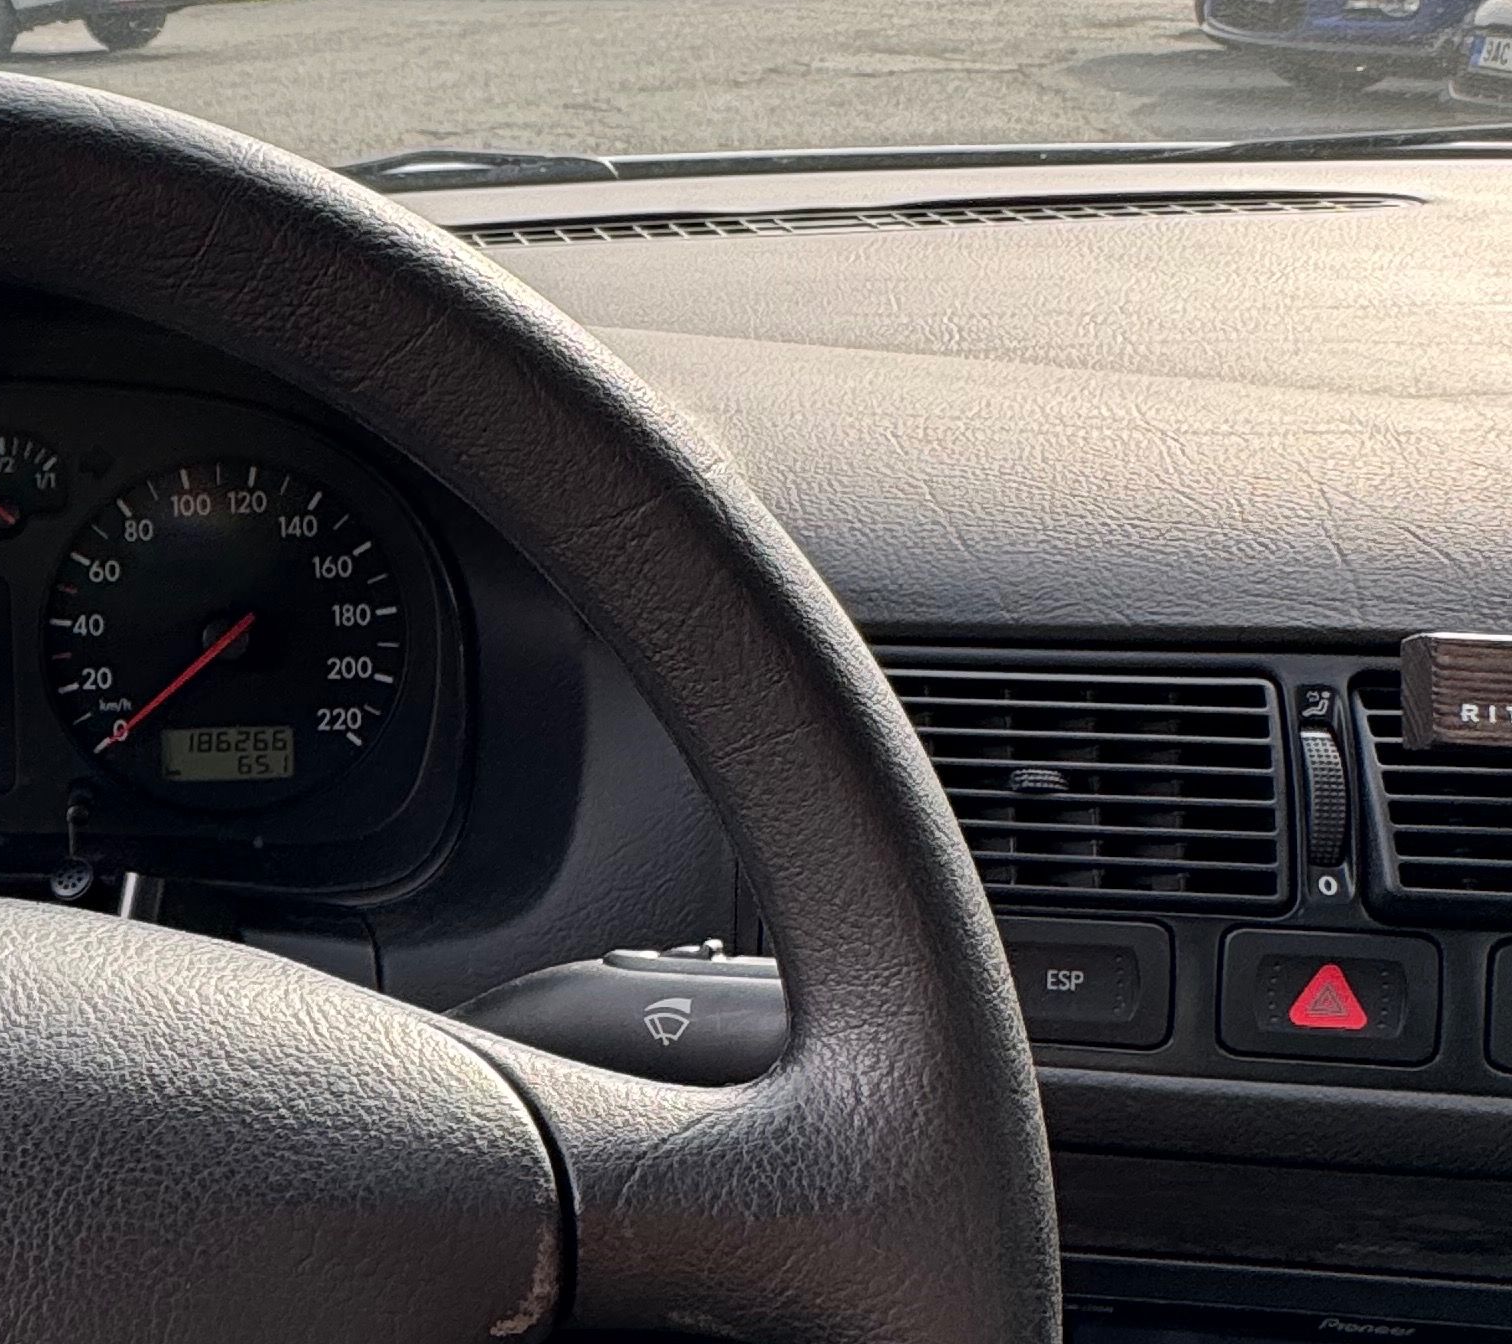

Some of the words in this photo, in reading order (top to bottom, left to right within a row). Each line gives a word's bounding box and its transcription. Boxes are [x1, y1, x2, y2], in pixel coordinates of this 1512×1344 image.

[170, 494, 211, 517] 100
[227, 490, 268, 514] 120
[123, 518, 154, 542] 80
[278, 514, 319, 538] 140
[88, 559, 121, 583] 60
[311, 555, 353, 579] 160
[72, 613, 105, 637] 40
[331, 603, 372, 627] 180
[81, 666, 113, 690] 20
[326, 656, 374, 680] 200
[98, 697, 132, 712] km/h
[112, 718, 129, 742] 0
[316, 708, 363, 732] 220
[188, 730, 288, 754] 186266
[1047, 969, 1084, 991] ESP
